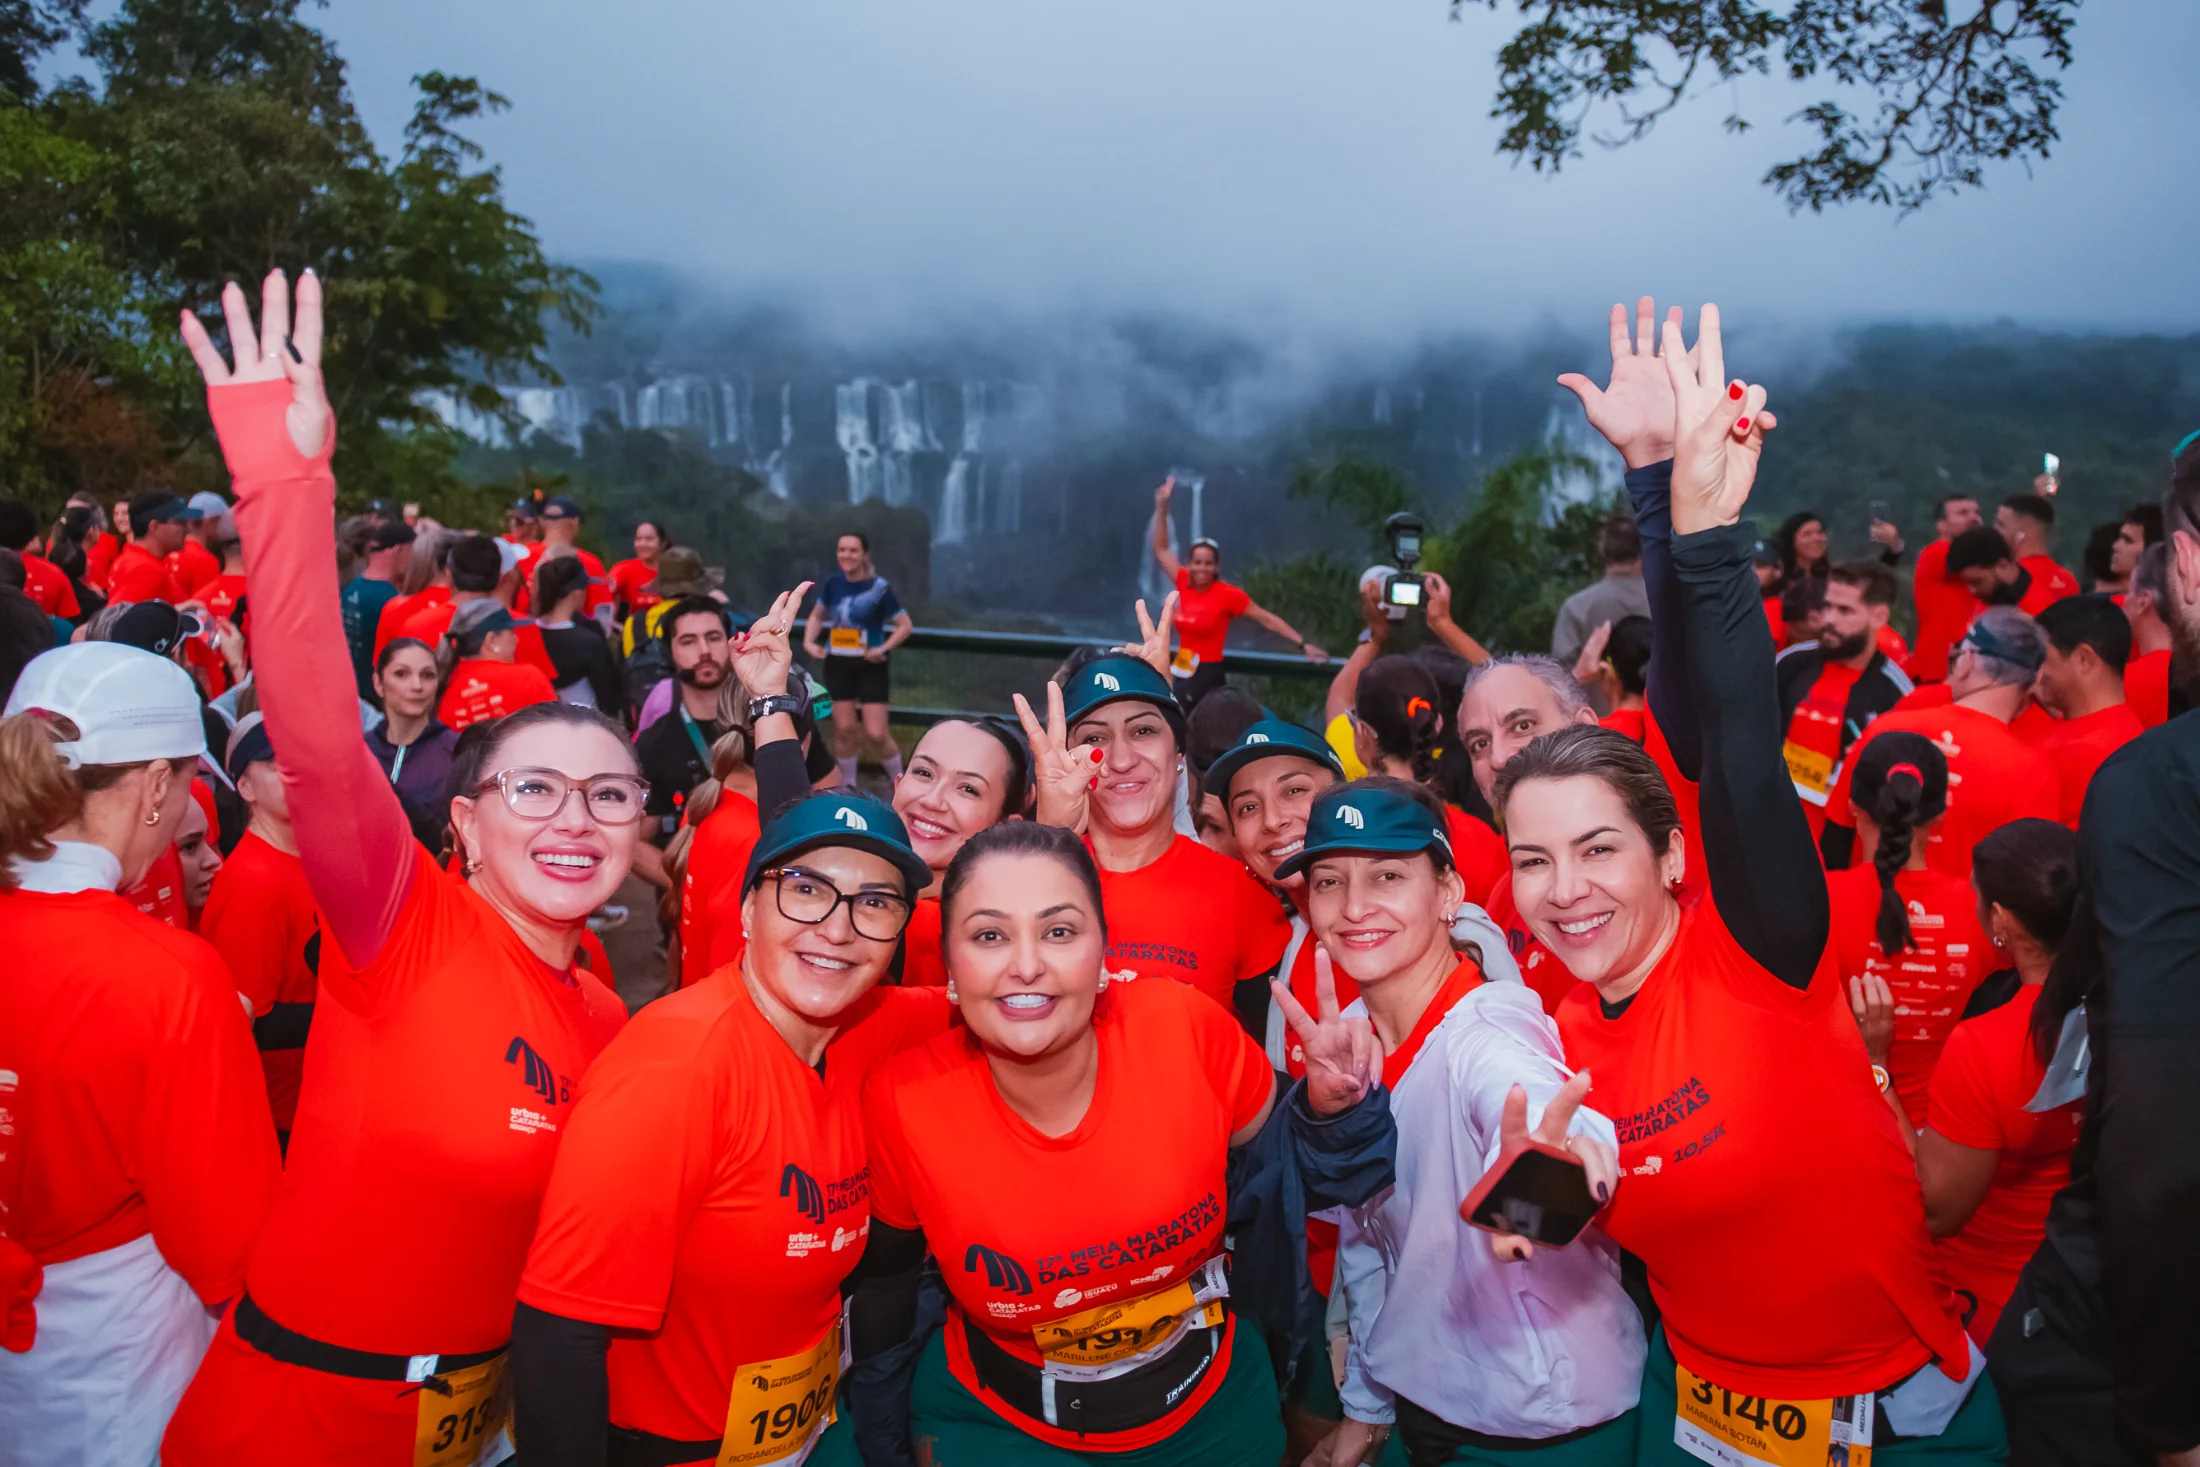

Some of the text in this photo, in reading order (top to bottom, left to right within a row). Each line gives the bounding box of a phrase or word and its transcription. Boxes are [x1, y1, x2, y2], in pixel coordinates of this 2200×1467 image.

[1104, 947, 1199, 971] ATARATAS
[1116, 941, 1197, 960] MARATONA
[1618, 1087, 1711, 1145] CATARATAS
[1633, 1076, 1702, 1125] MARATONA
[827, 1194, 848, 1215] DAS
[1070, 1241, 1122, 1262] MEIA
[1125, 1191, 1216, 1249] MARATONA
[1038, 1261, 1091, 1285] DAS
[1098, 1201, 1220, 1271] CATARATAS
[1052, 1350, 1112, 1363] MARILENE
[432, 1396, 492, 1454] 313
[750, 1373, 831, 1446] 1906
[1685, 1402, 1728, 1433] MARIANA
[1730, 1426, 1767, 1451] BOTAN
[1691, 1372, 1807, 1441] 3140
[728, 1439, 795, 1465] ROSANGELA
